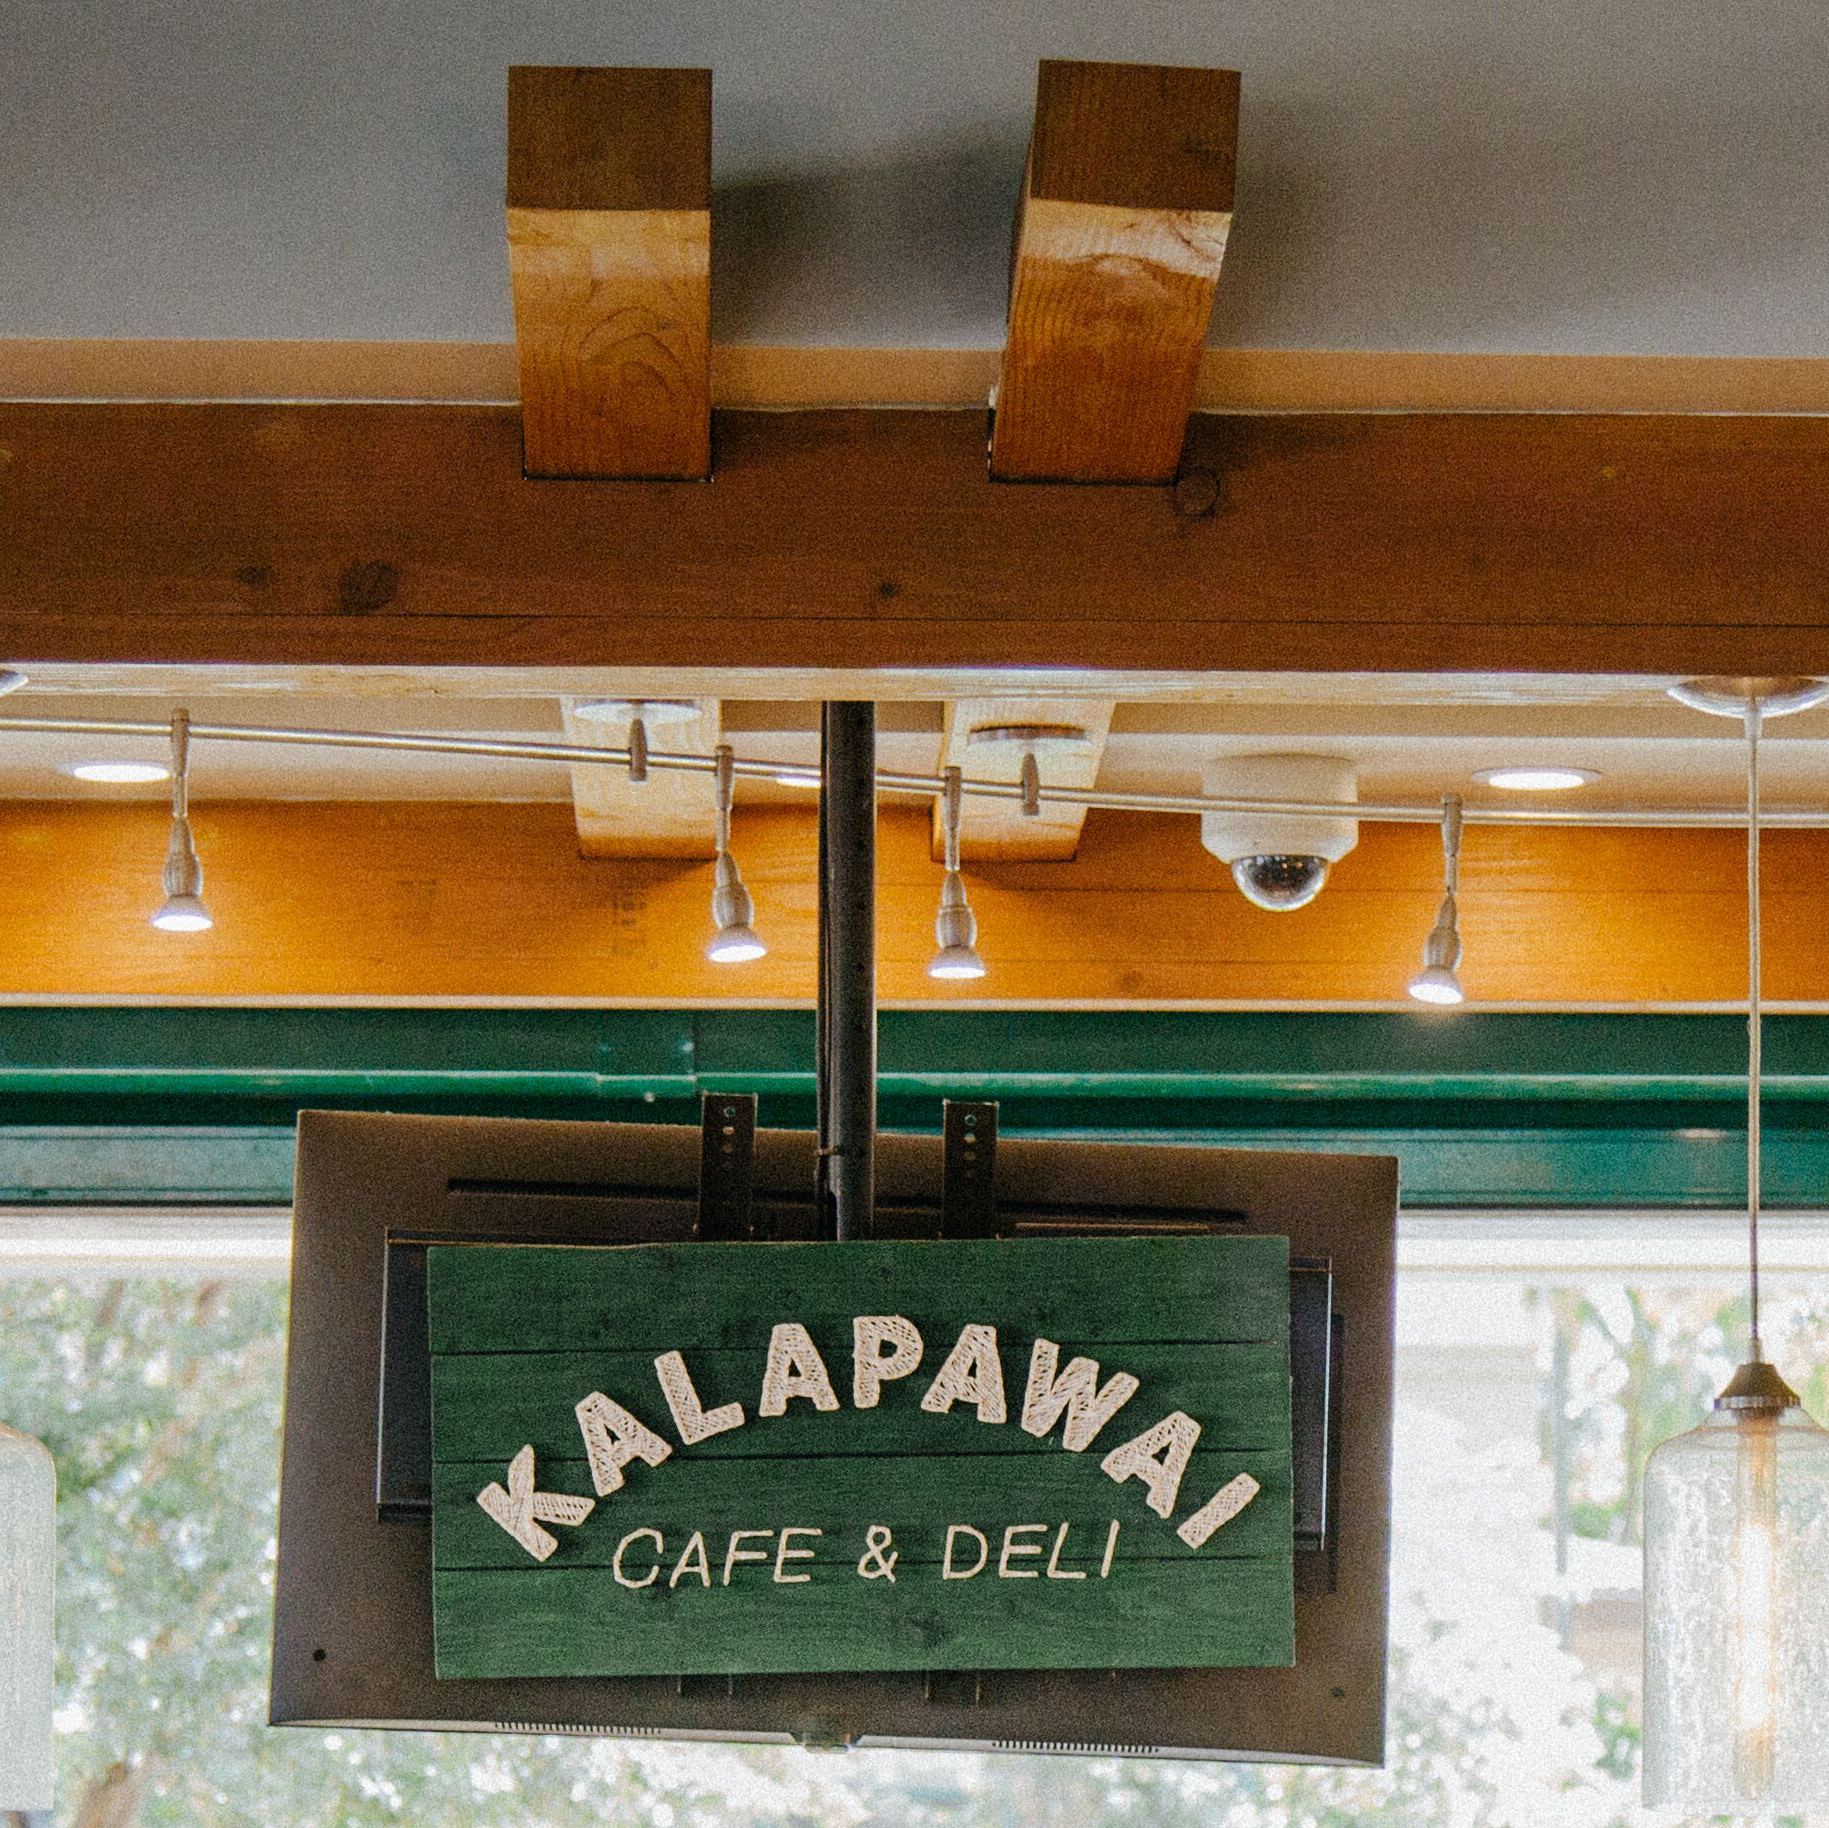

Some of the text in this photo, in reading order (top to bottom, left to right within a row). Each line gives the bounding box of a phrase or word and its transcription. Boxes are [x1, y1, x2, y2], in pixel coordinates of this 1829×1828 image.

[476, 1314, 1260, 1562] KALAPAWAI
[612, 1518, 1120, 1590] CAFE & DELI
